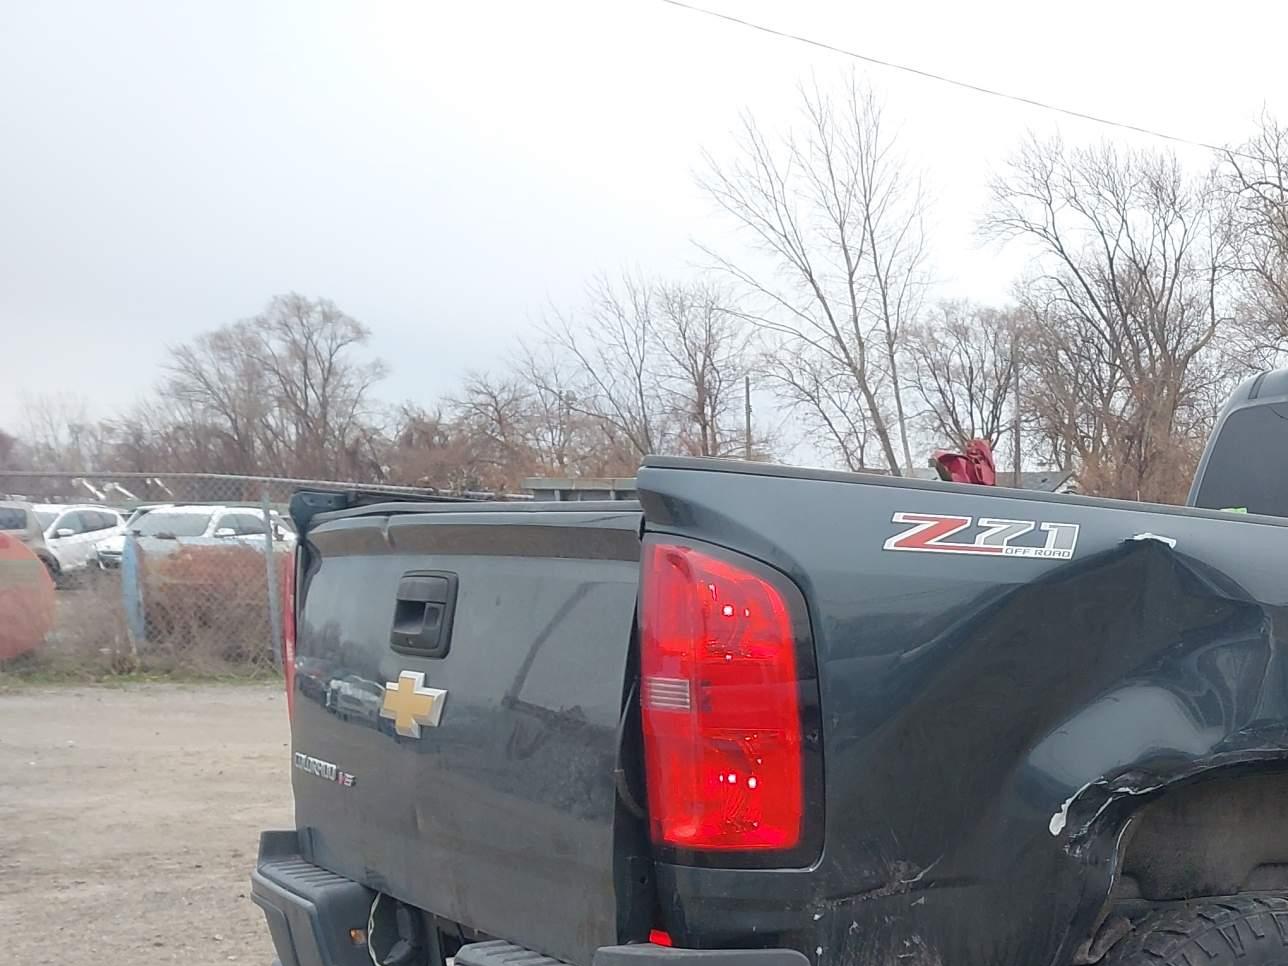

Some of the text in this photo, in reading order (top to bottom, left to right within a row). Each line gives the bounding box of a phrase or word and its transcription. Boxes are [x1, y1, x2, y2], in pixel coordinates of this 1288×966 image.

[882, 511, 1080, 557] Z71
[1004, 547, 1071, 558] OFF ROAD
